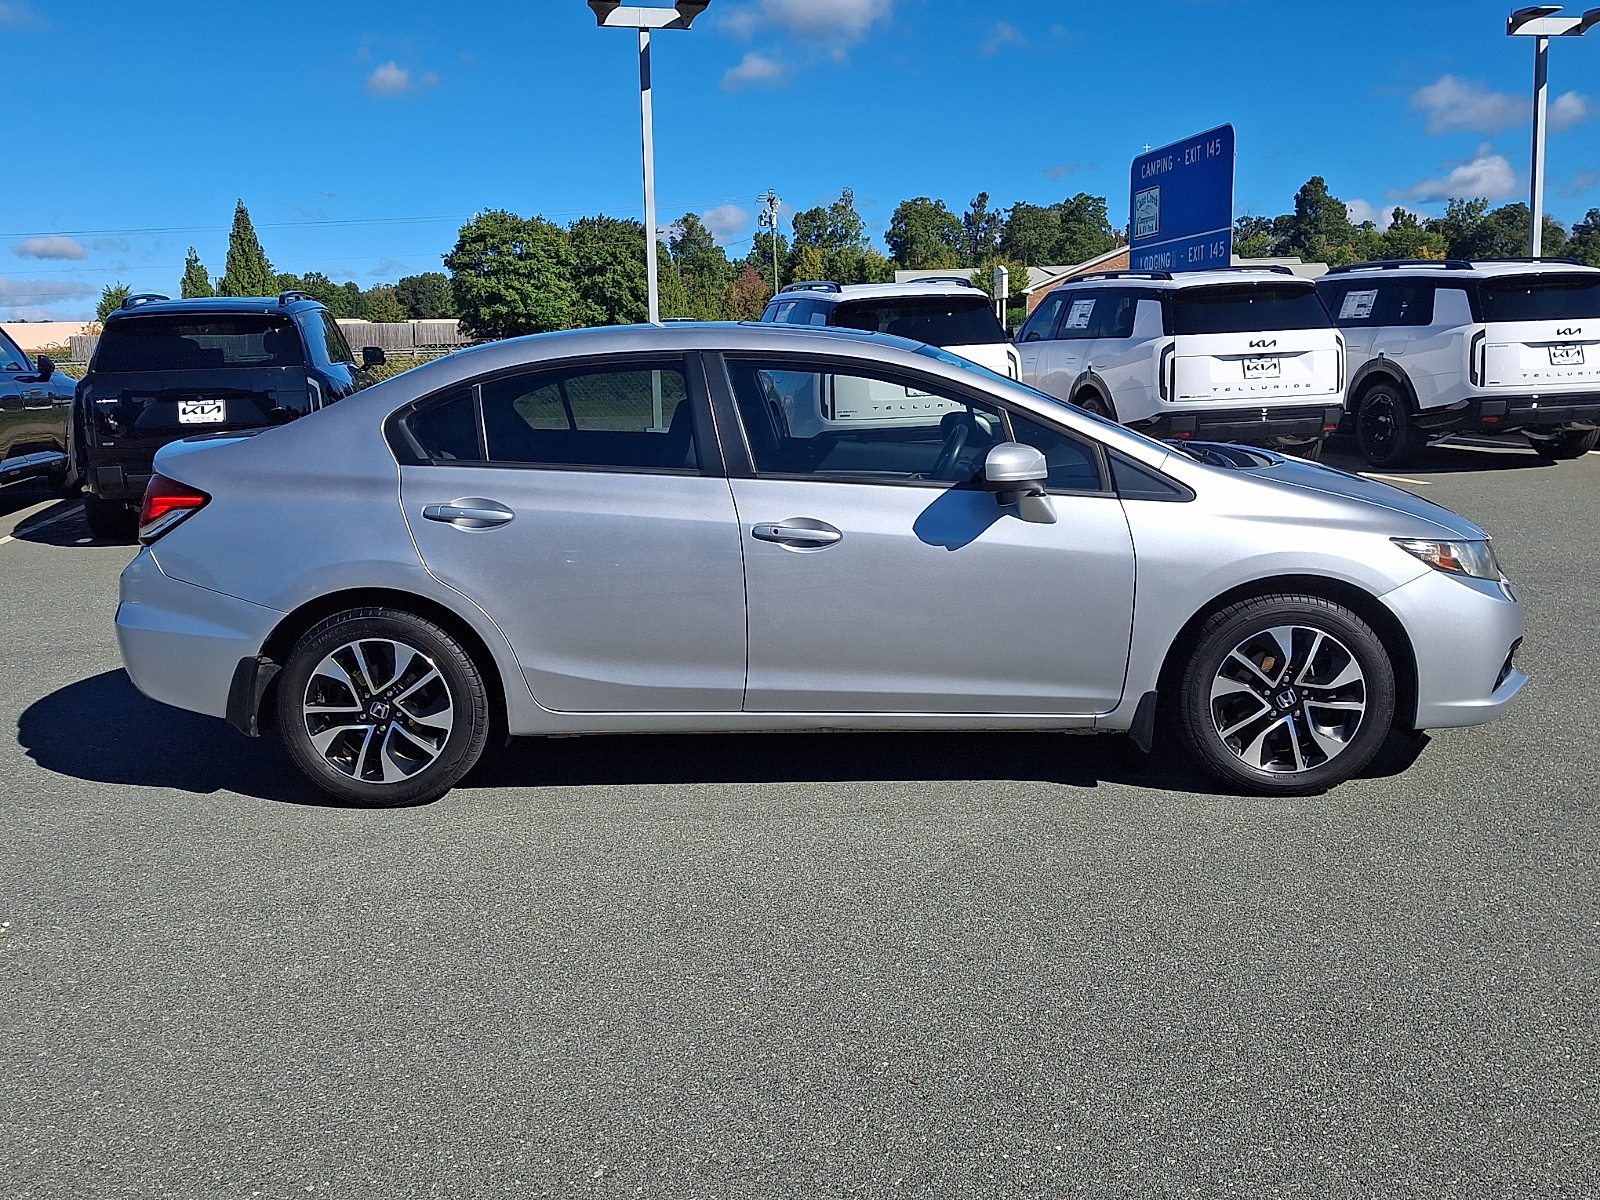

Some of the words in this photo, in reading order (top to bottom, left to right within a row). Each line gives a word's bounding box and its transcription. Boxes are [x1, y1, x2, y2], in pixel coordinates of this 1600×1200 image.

[1141, 155, 1173, 179] CAMPING
[1185, 145, 1202, 166] EXIT
[1206, 138, 1221, 158] 145
[1140, 252, 1172, 272] LODGING
[1188, 244, 1205, 263] EXIT
[1209, 241, 1225, 259] 145
[1557, 327, 1582, 336] KIA
[1249, 339, 1276, 348] KIA
[1553, 349, 1581, 359] KIA
[1246, 362, 1278, 372] KIA
[1212, 382, 1311, 393] TELLURIDE
[181, 405, 222, 416] KIA
